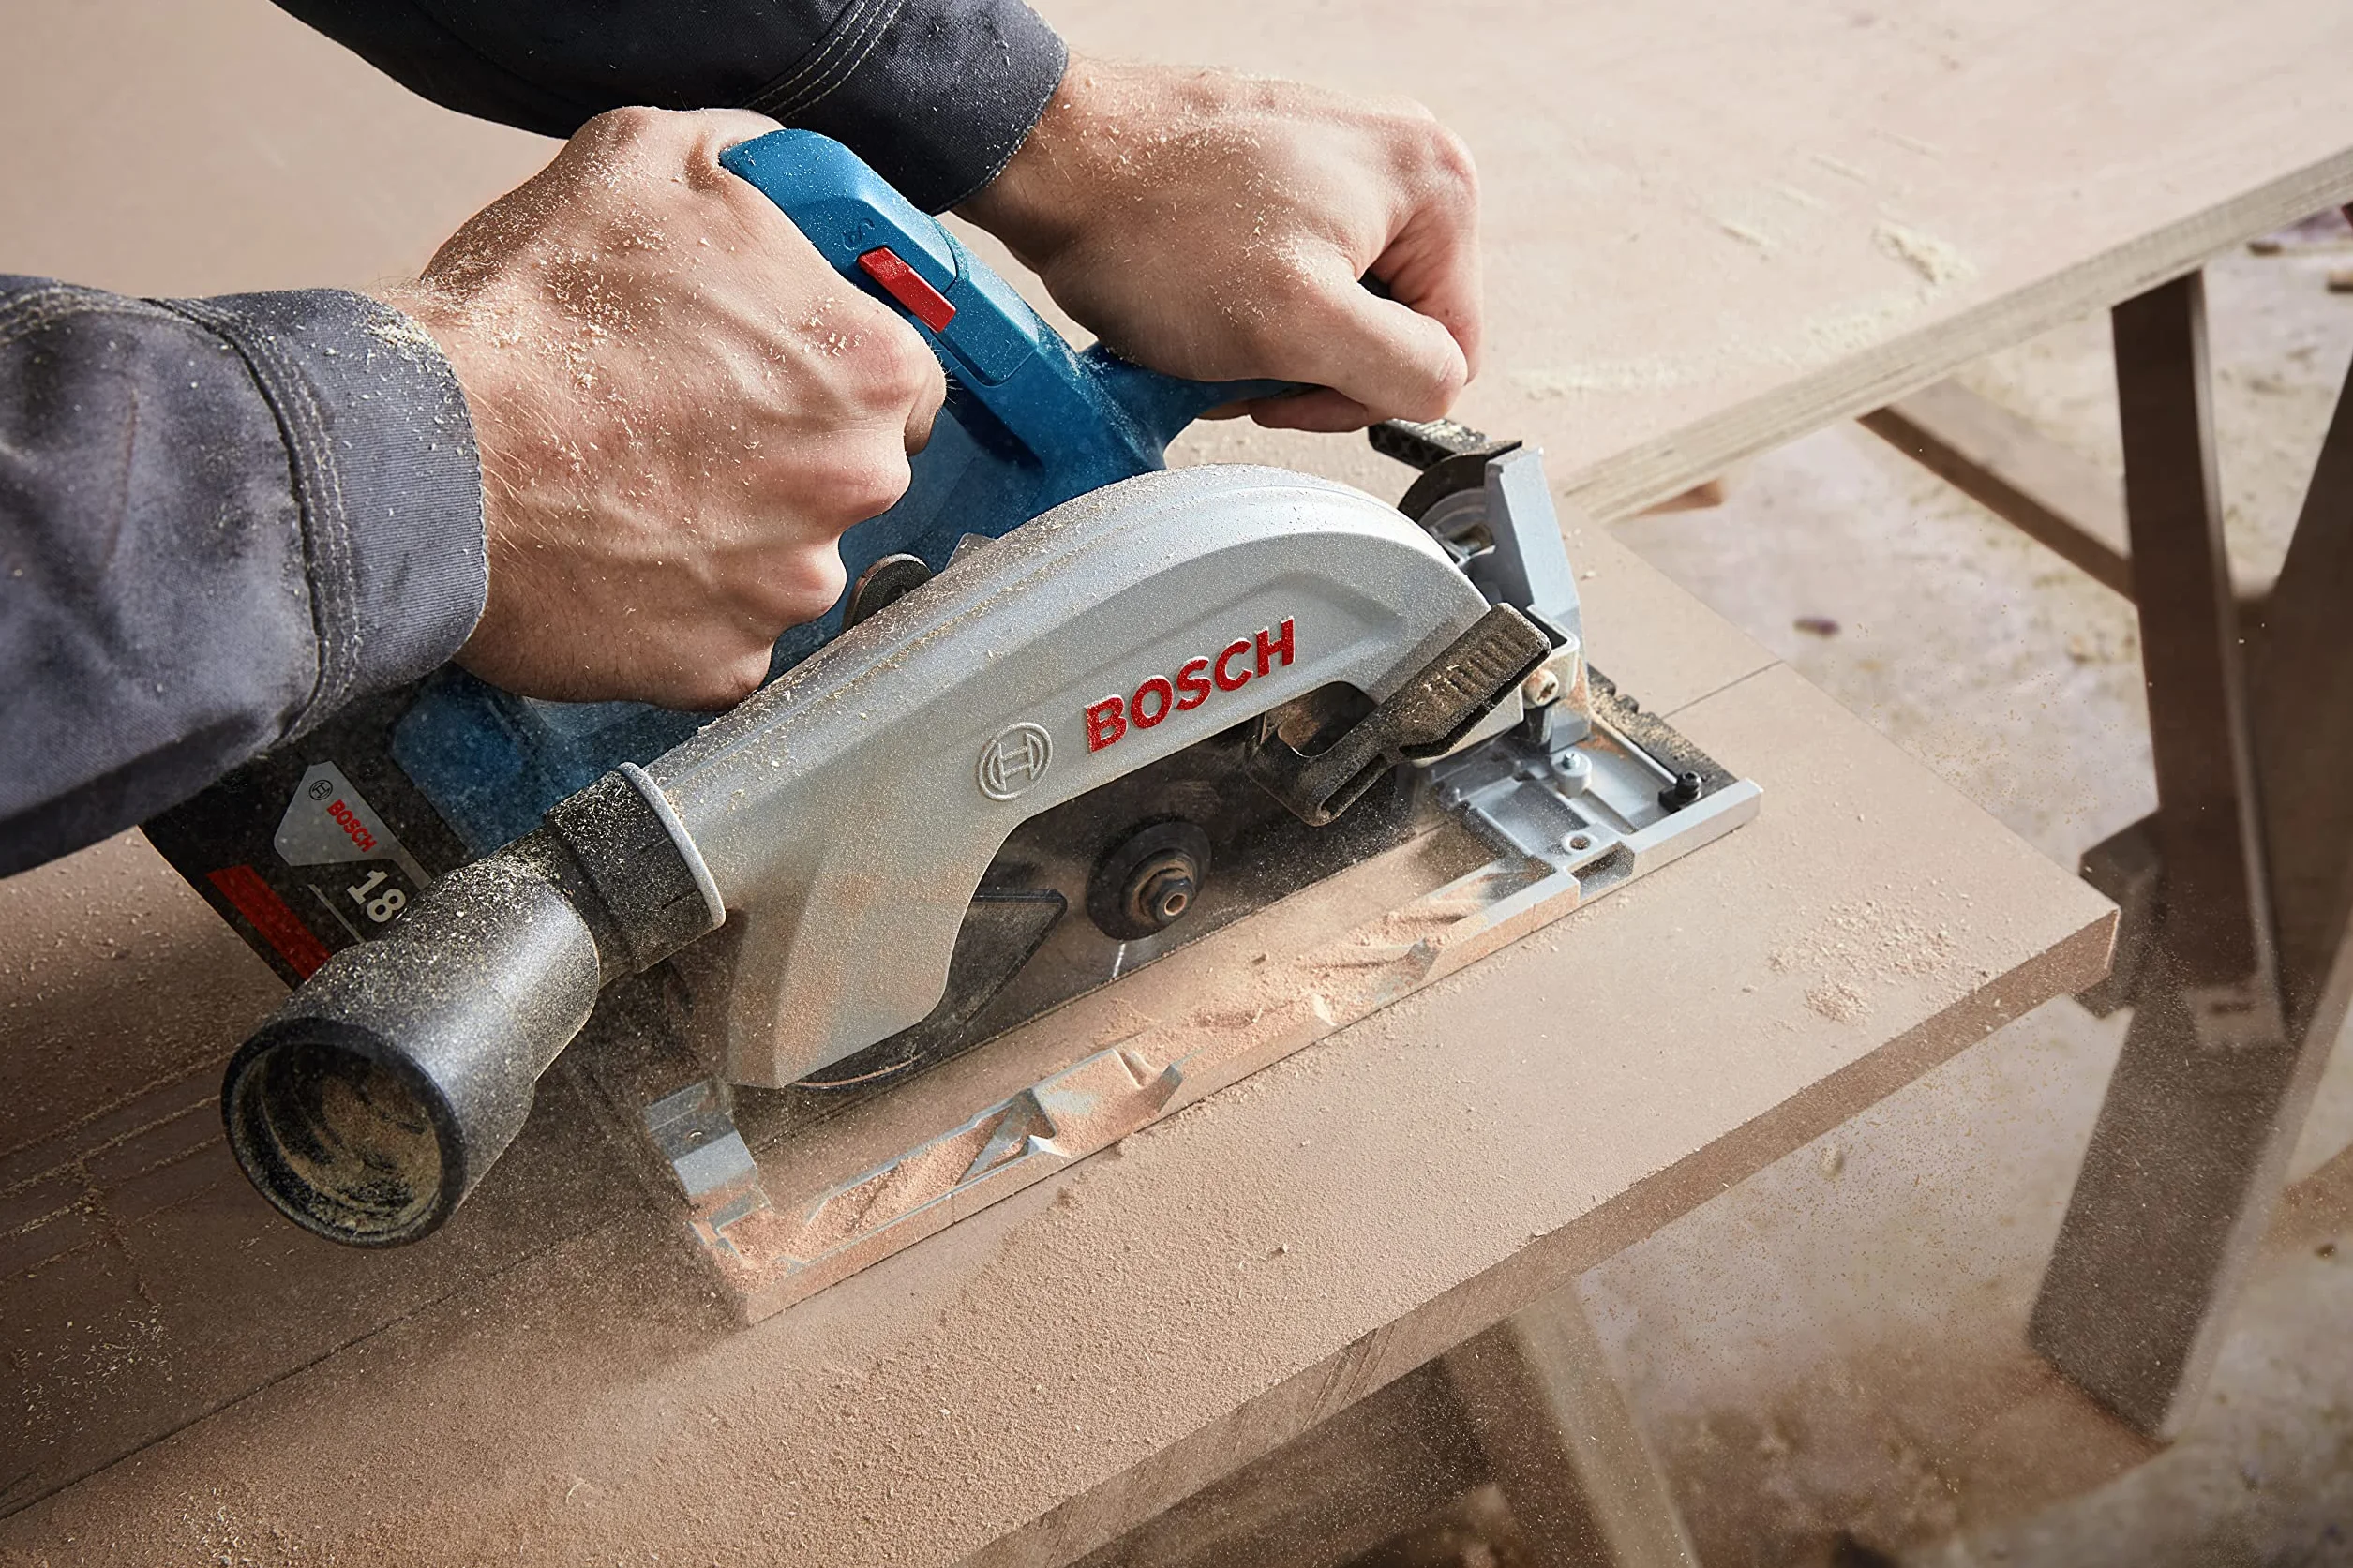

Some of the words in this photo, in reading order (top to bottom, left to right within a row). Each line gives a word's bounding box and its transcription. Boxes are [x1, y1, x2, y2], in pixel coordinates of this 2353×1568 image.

[1085, 616, 1295, 753] BOSCH
[326, 799, 378, 853] BOSCH
[346, 870, 406, 923] 18
